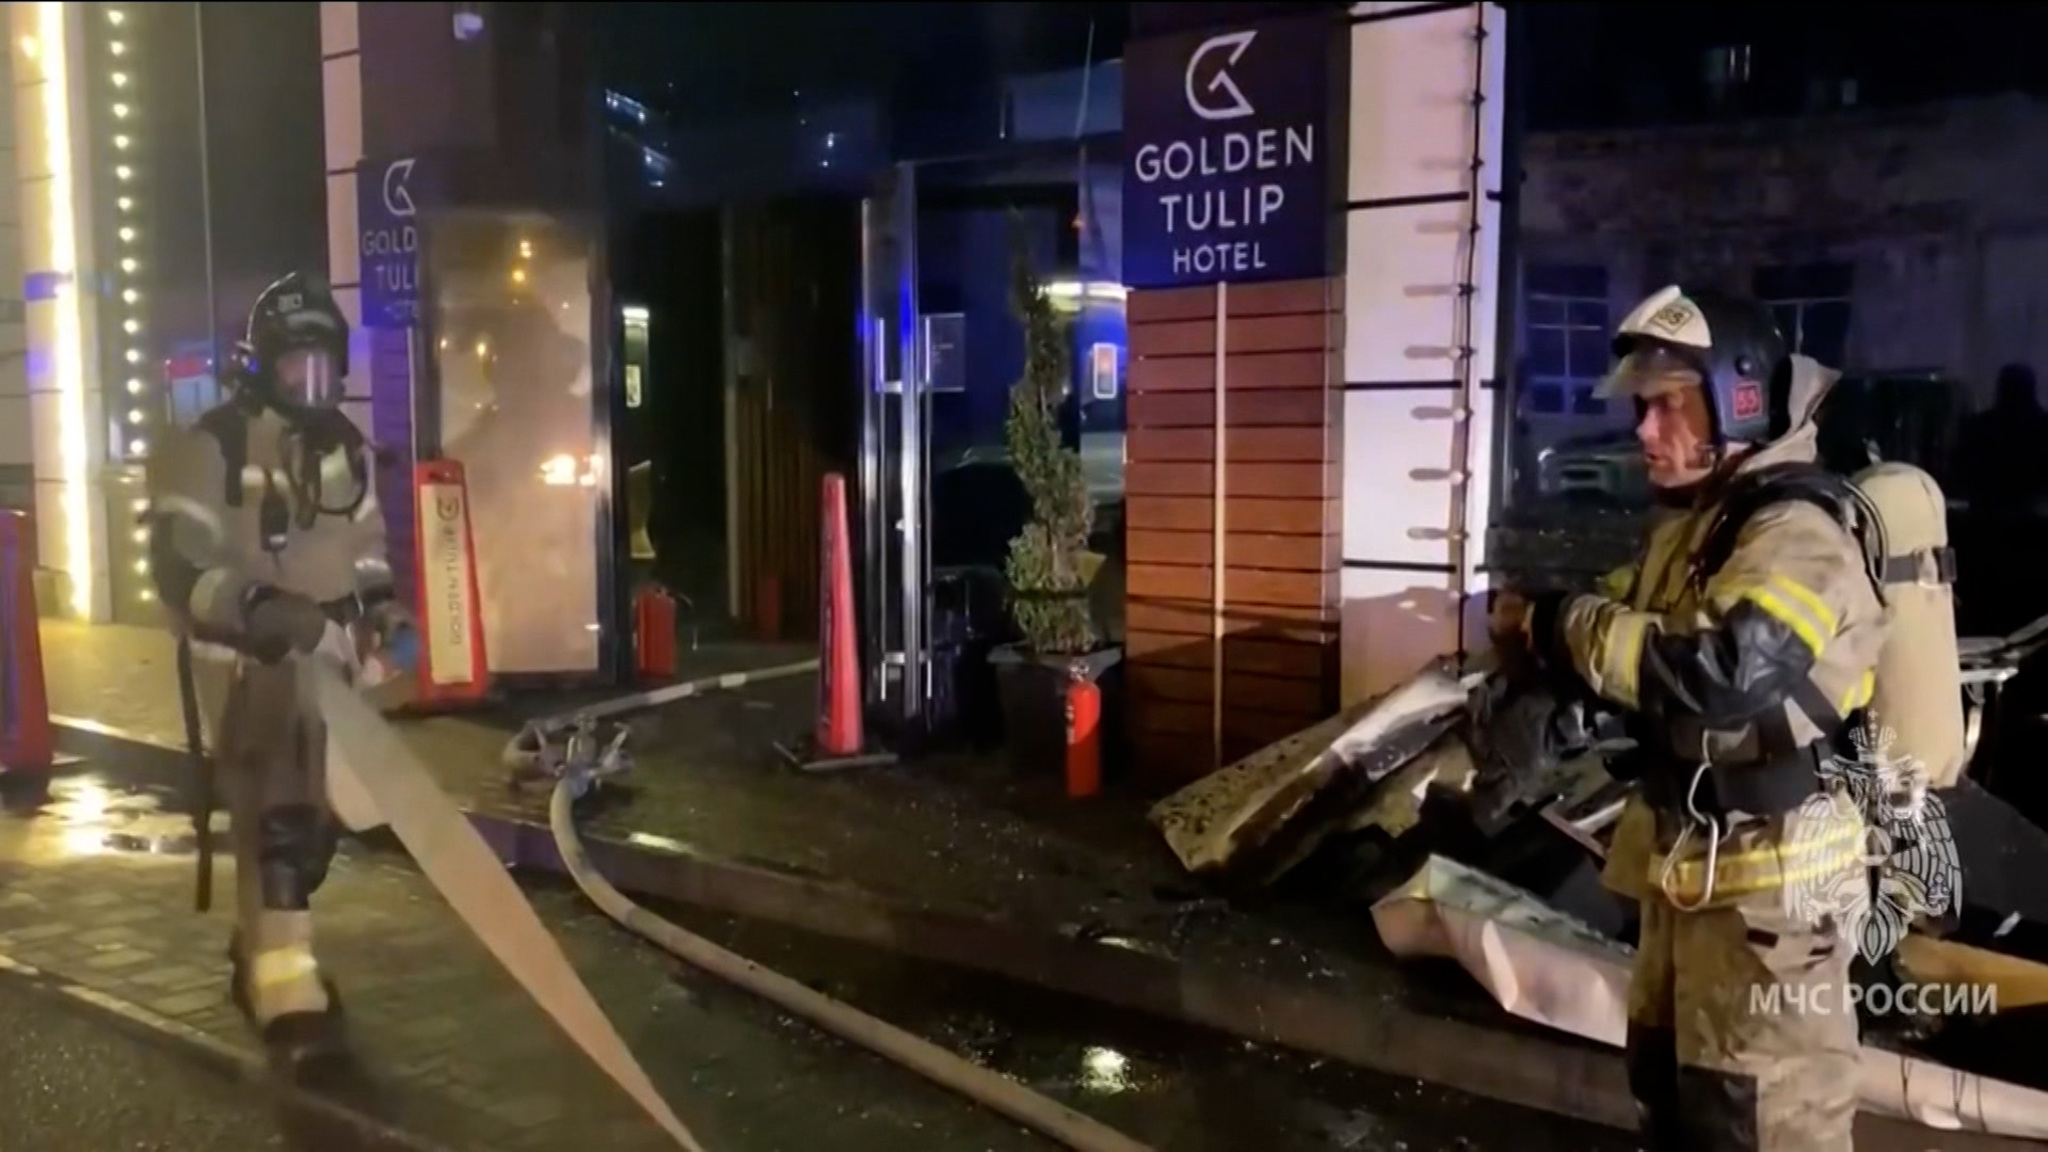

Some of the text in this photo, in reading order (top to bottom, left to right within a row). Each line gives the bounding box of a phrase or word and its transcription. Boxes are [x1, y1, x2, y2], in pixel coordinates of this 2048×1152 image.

[1135, 123, 1314, 183] GOLDEN
[1159, 184, 1285, 233] TULIP
[362, 225, 418, 256] GOLD
[1173, 241, 1267, 274] HOTEL
